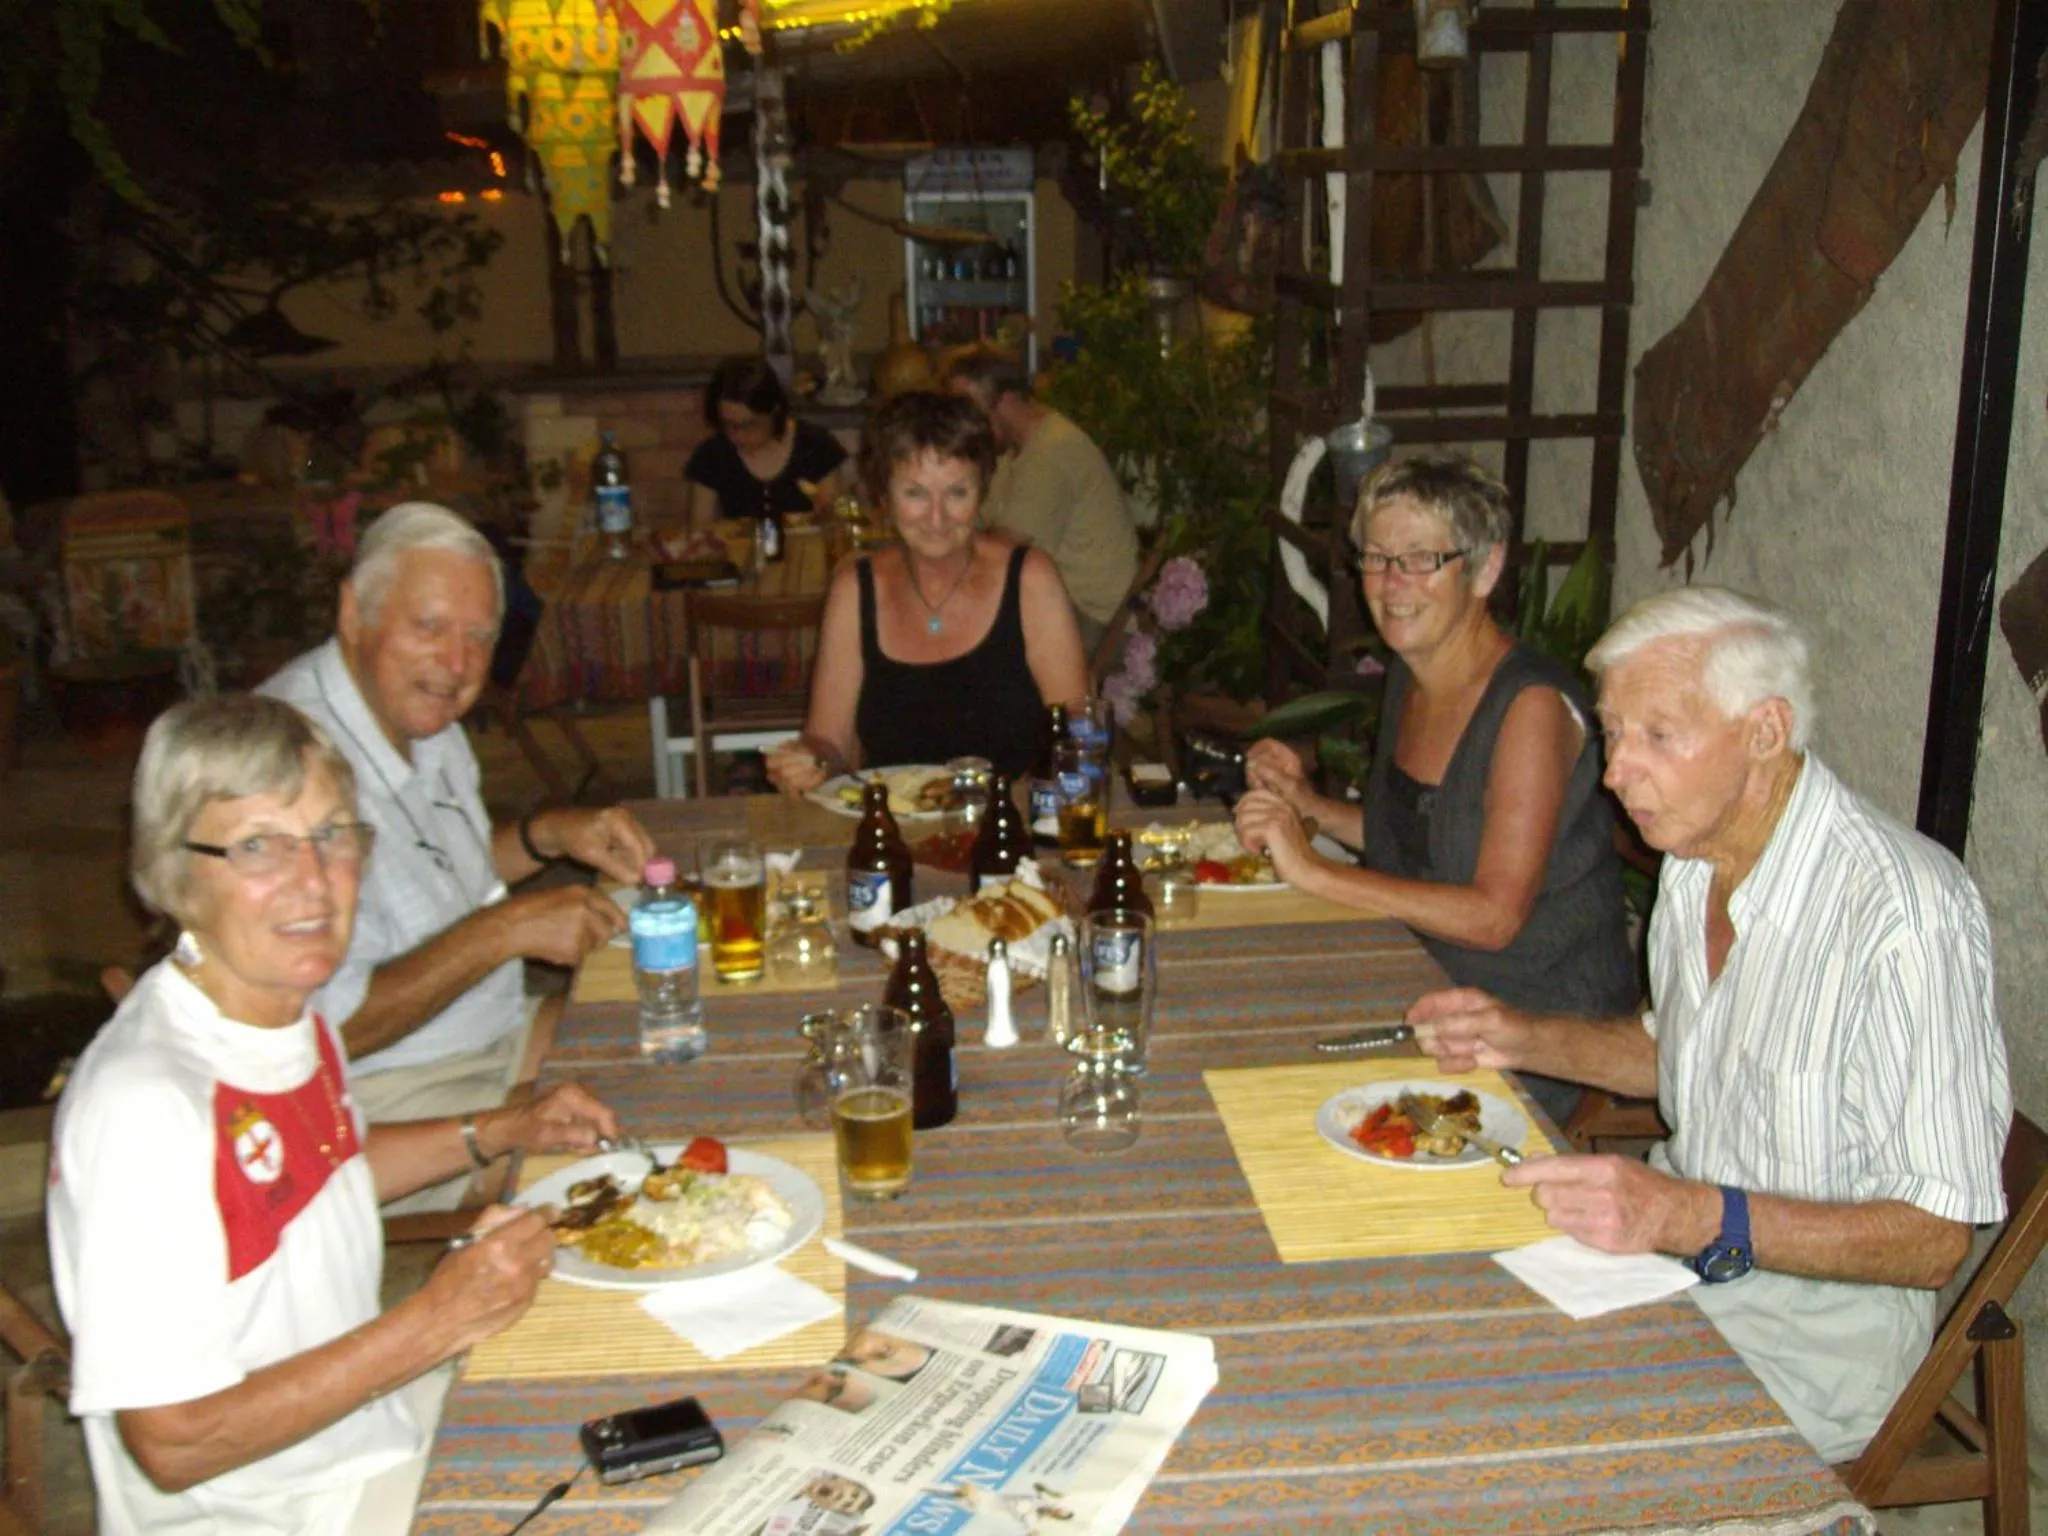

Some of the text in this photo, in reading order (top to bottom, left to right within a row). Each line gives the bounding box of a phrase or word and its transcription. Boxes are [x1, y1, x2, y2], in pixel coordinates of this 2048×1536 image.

[945, 1366, 1019, 1430] Dropping
[977, 1389, 1074, 1464] DAILY
[892, 1425, 963, 1483] blinders
[905, 1460, 1009, 1534] NWS
